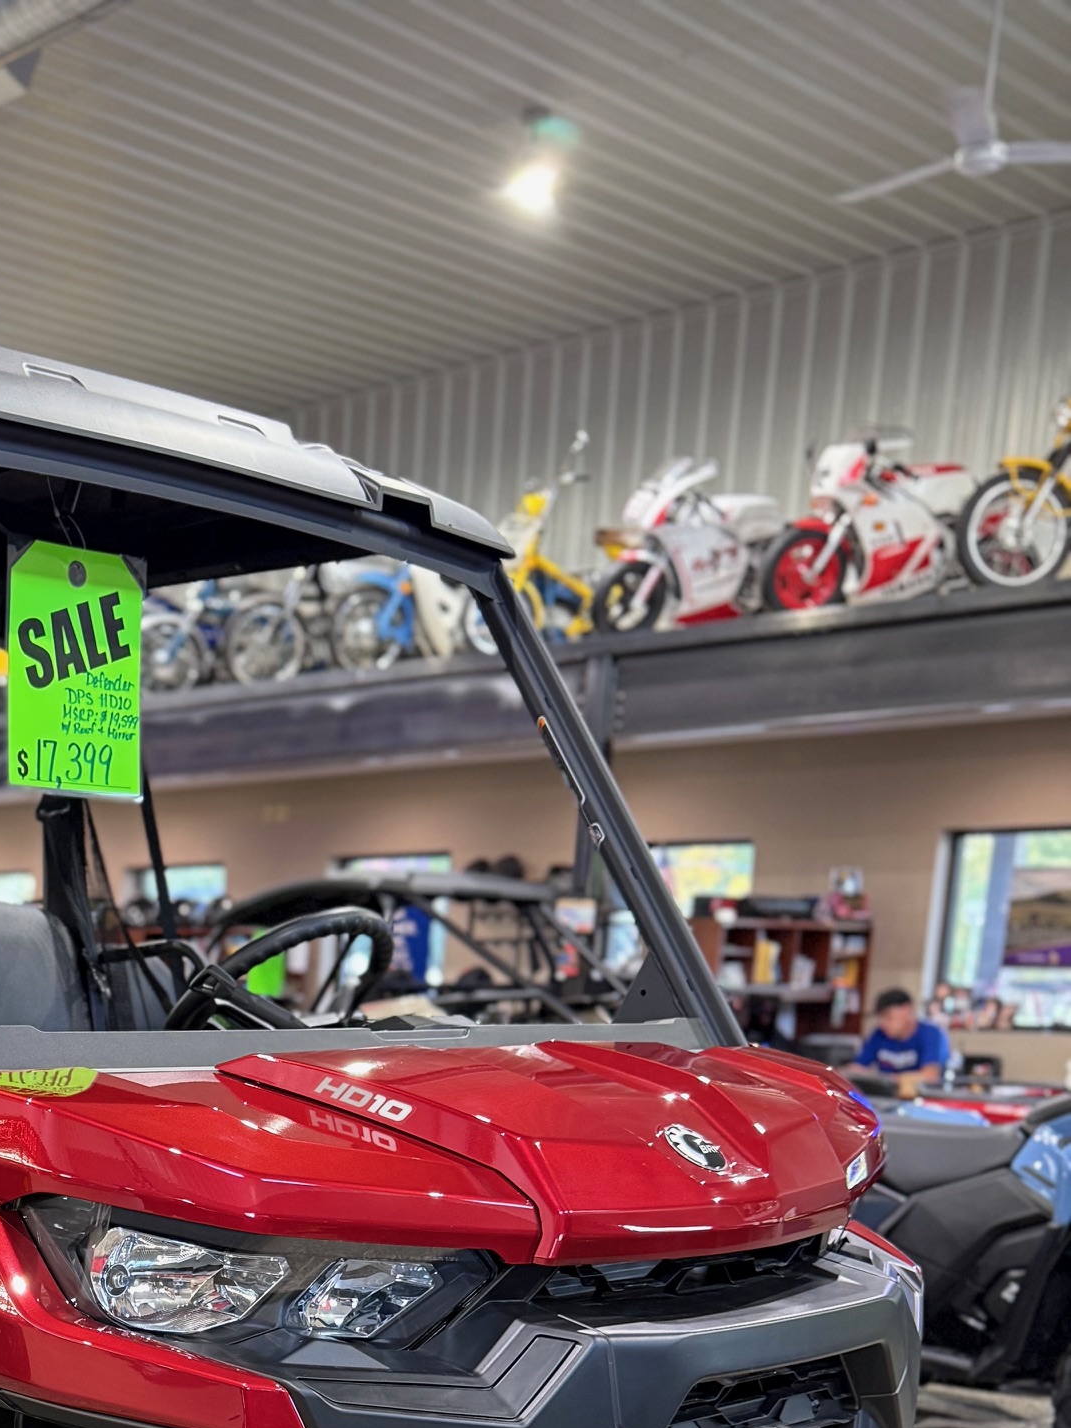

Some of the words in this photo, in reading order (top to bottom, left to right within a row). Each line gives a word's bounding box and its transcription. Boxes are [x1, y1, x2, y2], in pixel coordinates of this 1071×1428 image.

[17, 591, 131, 689] SALE
[65, 687, 94, 706] DPS
[99, 692, 132, 711] HD10
[86, 671, 135, 692] Defender
[314, 1076, 413, 1122] HD10
